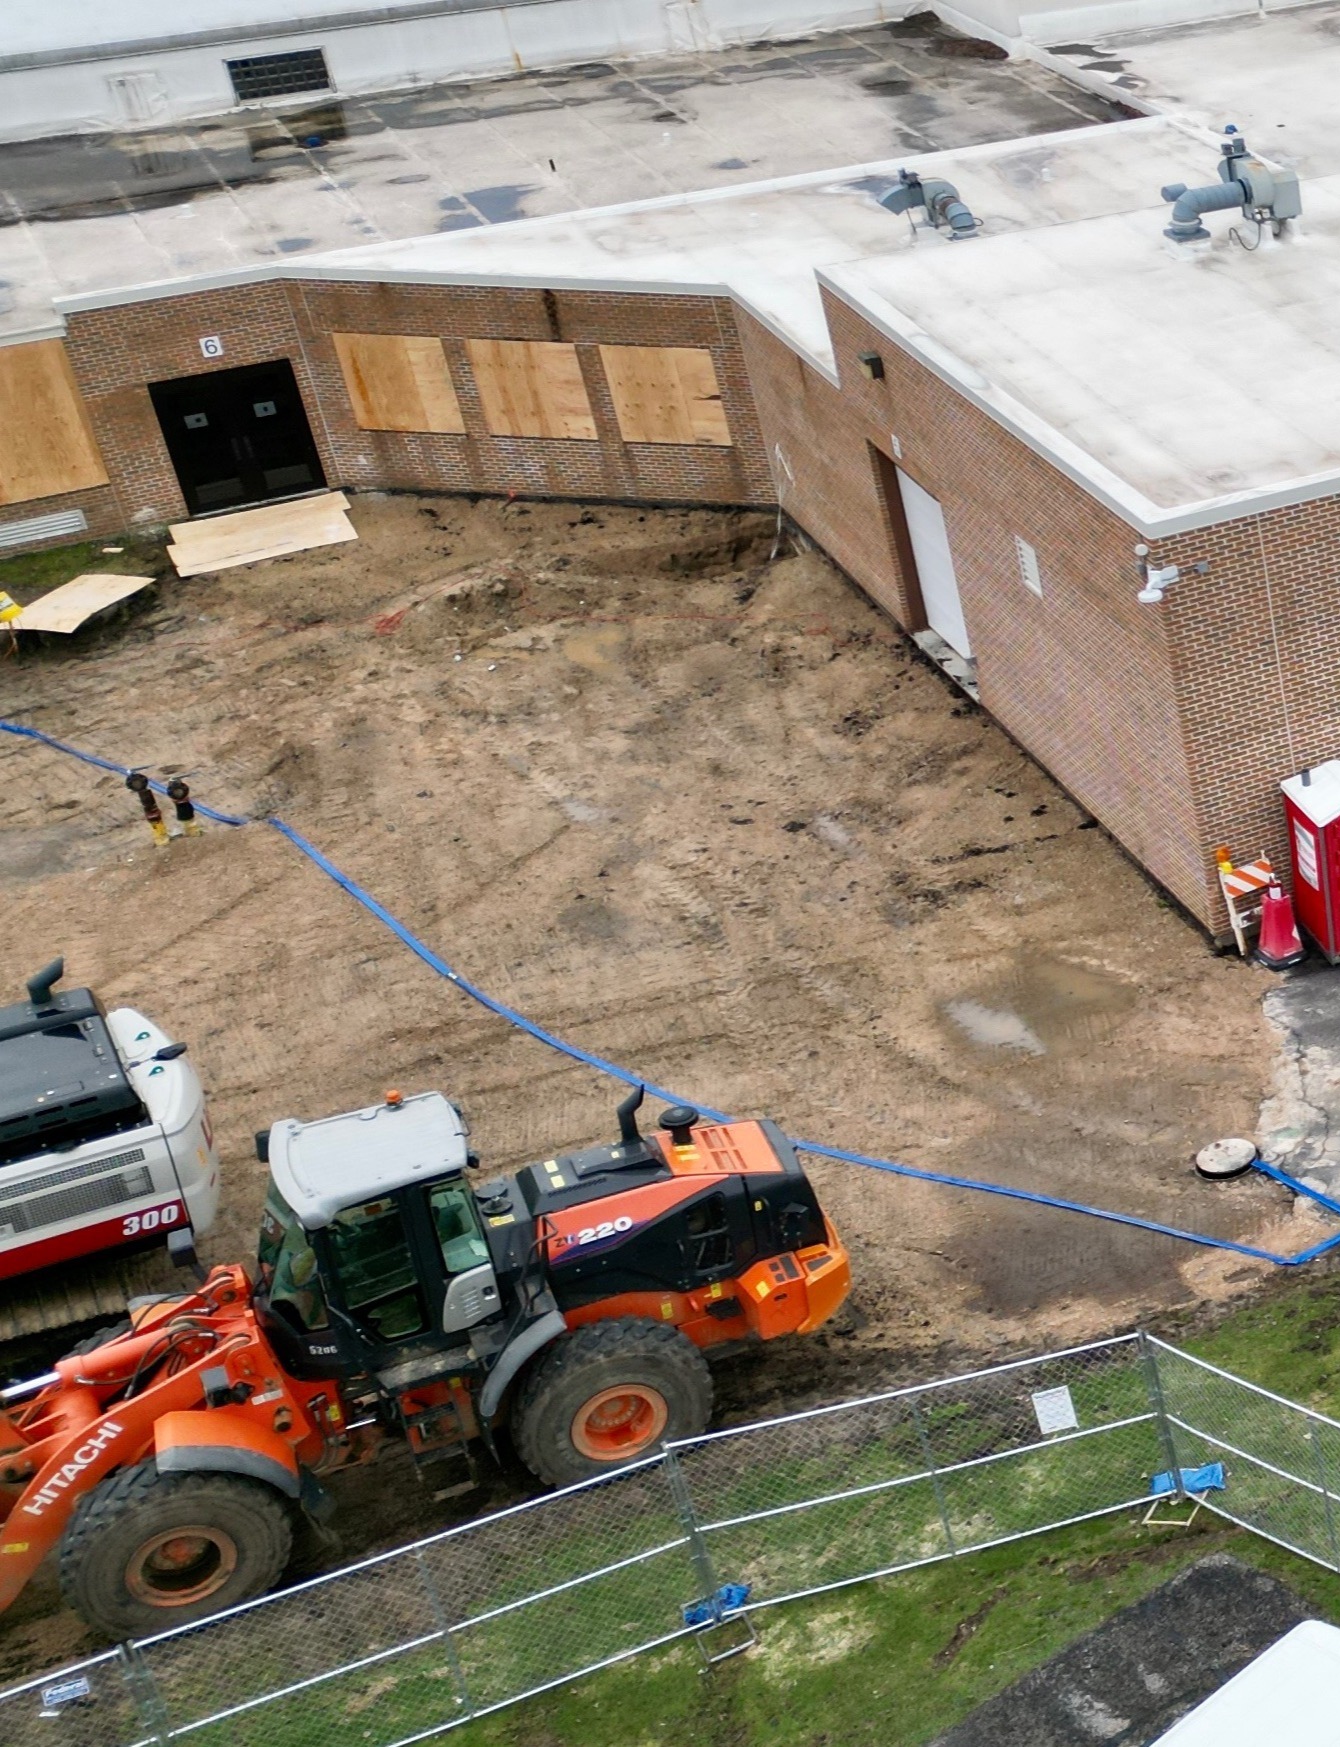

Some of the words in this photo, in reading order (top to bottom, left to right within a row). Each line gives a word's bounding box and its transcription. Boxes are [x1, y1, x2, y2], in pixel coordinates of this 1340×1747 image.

[204, 339, 218, 354] 6
[122, 1204, 179, 1237] 300
[577, 1216, 633, 1246] 220
[22, 1421, 124, 1516] HITACHI
